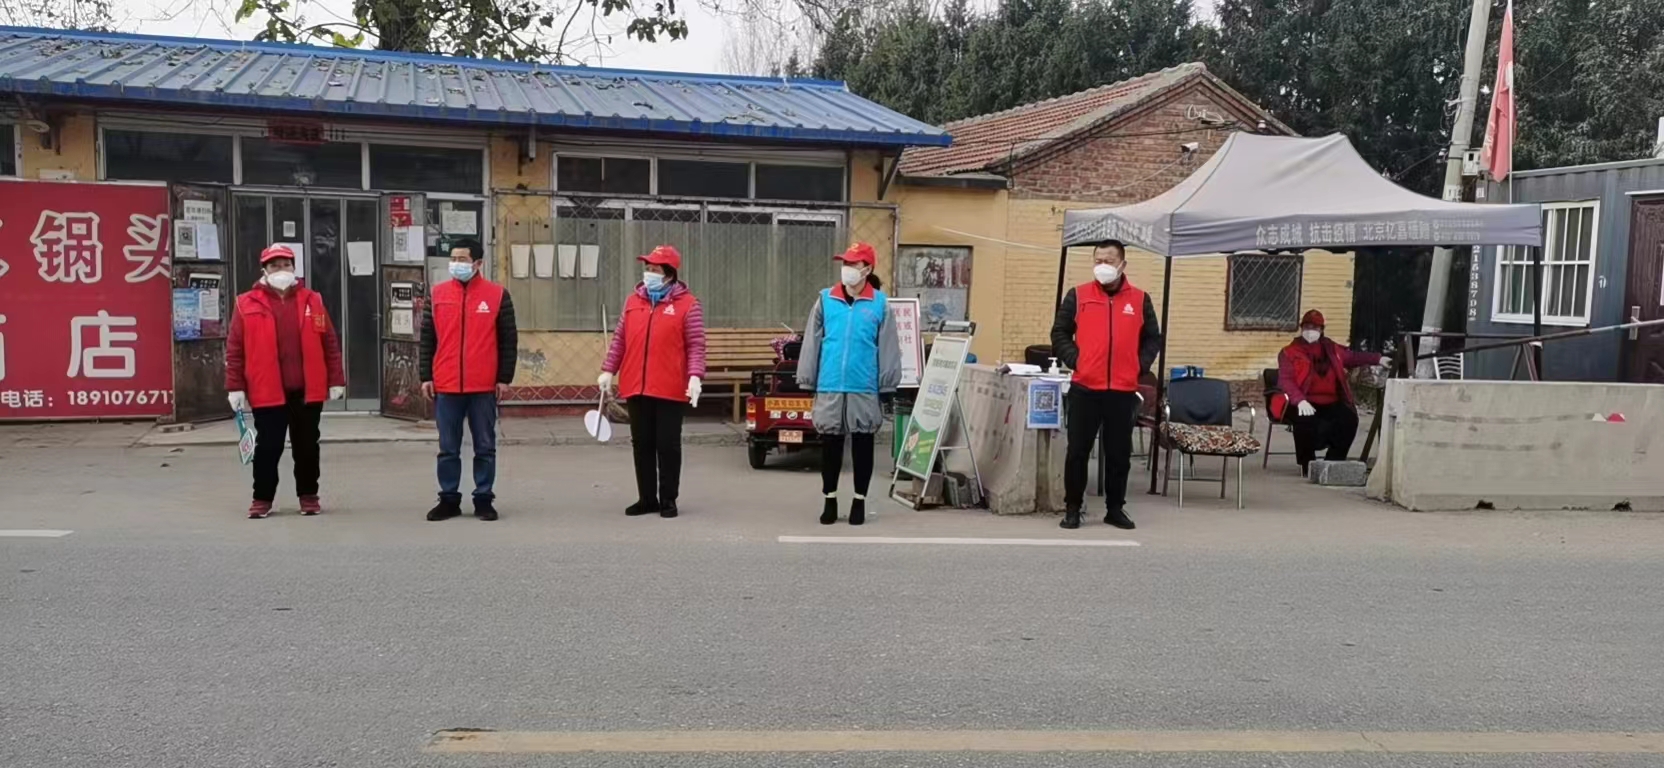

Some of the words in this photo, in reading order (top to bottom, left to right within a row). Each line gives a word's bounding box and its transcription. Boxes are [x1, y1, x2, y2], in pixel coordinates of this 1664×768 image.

[0, 210, 170, 284] 锅头
[1309, 221, 1357, 244] 抗击疫情
